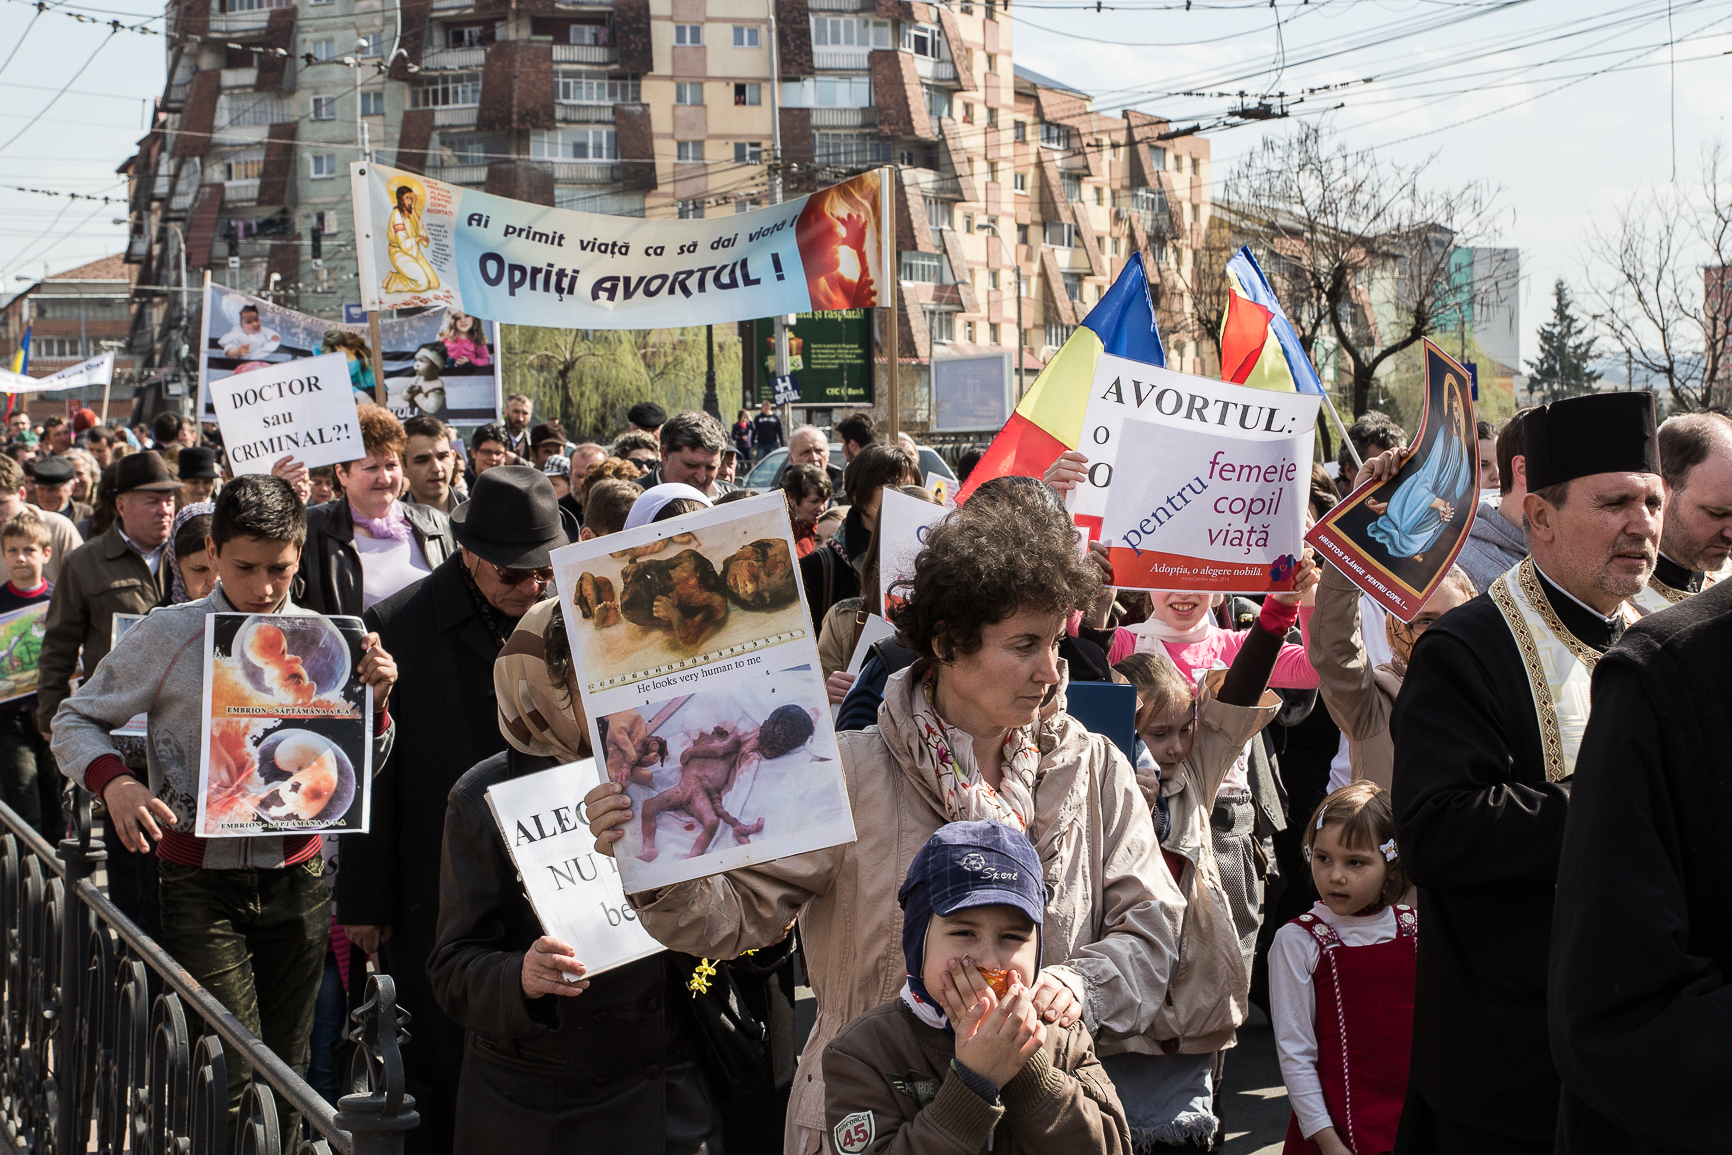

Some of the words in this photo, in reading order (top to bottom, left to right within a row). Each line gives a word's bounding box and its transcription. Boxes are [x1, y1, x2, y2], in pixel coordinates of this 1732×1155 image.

[467, 212, 490, 228] Ai
[502, 224, 566, 248] primit
[644, 245, 666, 256] ca
[677, 240, 699, 256] să
[710, 232, 739, 250] dai
[590, 256, 762, 302] AVORTUL
[770, 252, 786, 282] !
[231, 375, 323, 410] DOCTOR
[1100, 375, 1296, 434] AVORTUL:
[262, 411, 294, 429] sau
[231, 423, 351, 464] CRIMINAL?!
[1208, 450, 1297, 483] femeie
[1121, 476, 1209, 558] pentru
[1213, 487, 1283, 524] copil
[1200, 566, 1232, 578] alegere
[1233, 566, 1263, 576] nobilă.
[1318, 534, 1344, 557] HRISTOS
[1364, 574, 1388, 593] PENTRU
[637, 681, 650, 694] He
[652, 675, 677, 690] looks
[679, 670, 699, 685] very
[700, 662, 733, 679] human
[734, 660, 744, 671] to
[746, 655, 762, 668] me
[226, 706, 267, 714] EMBRION
[546, 852, 598, 890] NU
[980, 867, 1019, 881] Sport
[843, 1123, 868, 1147] 45
